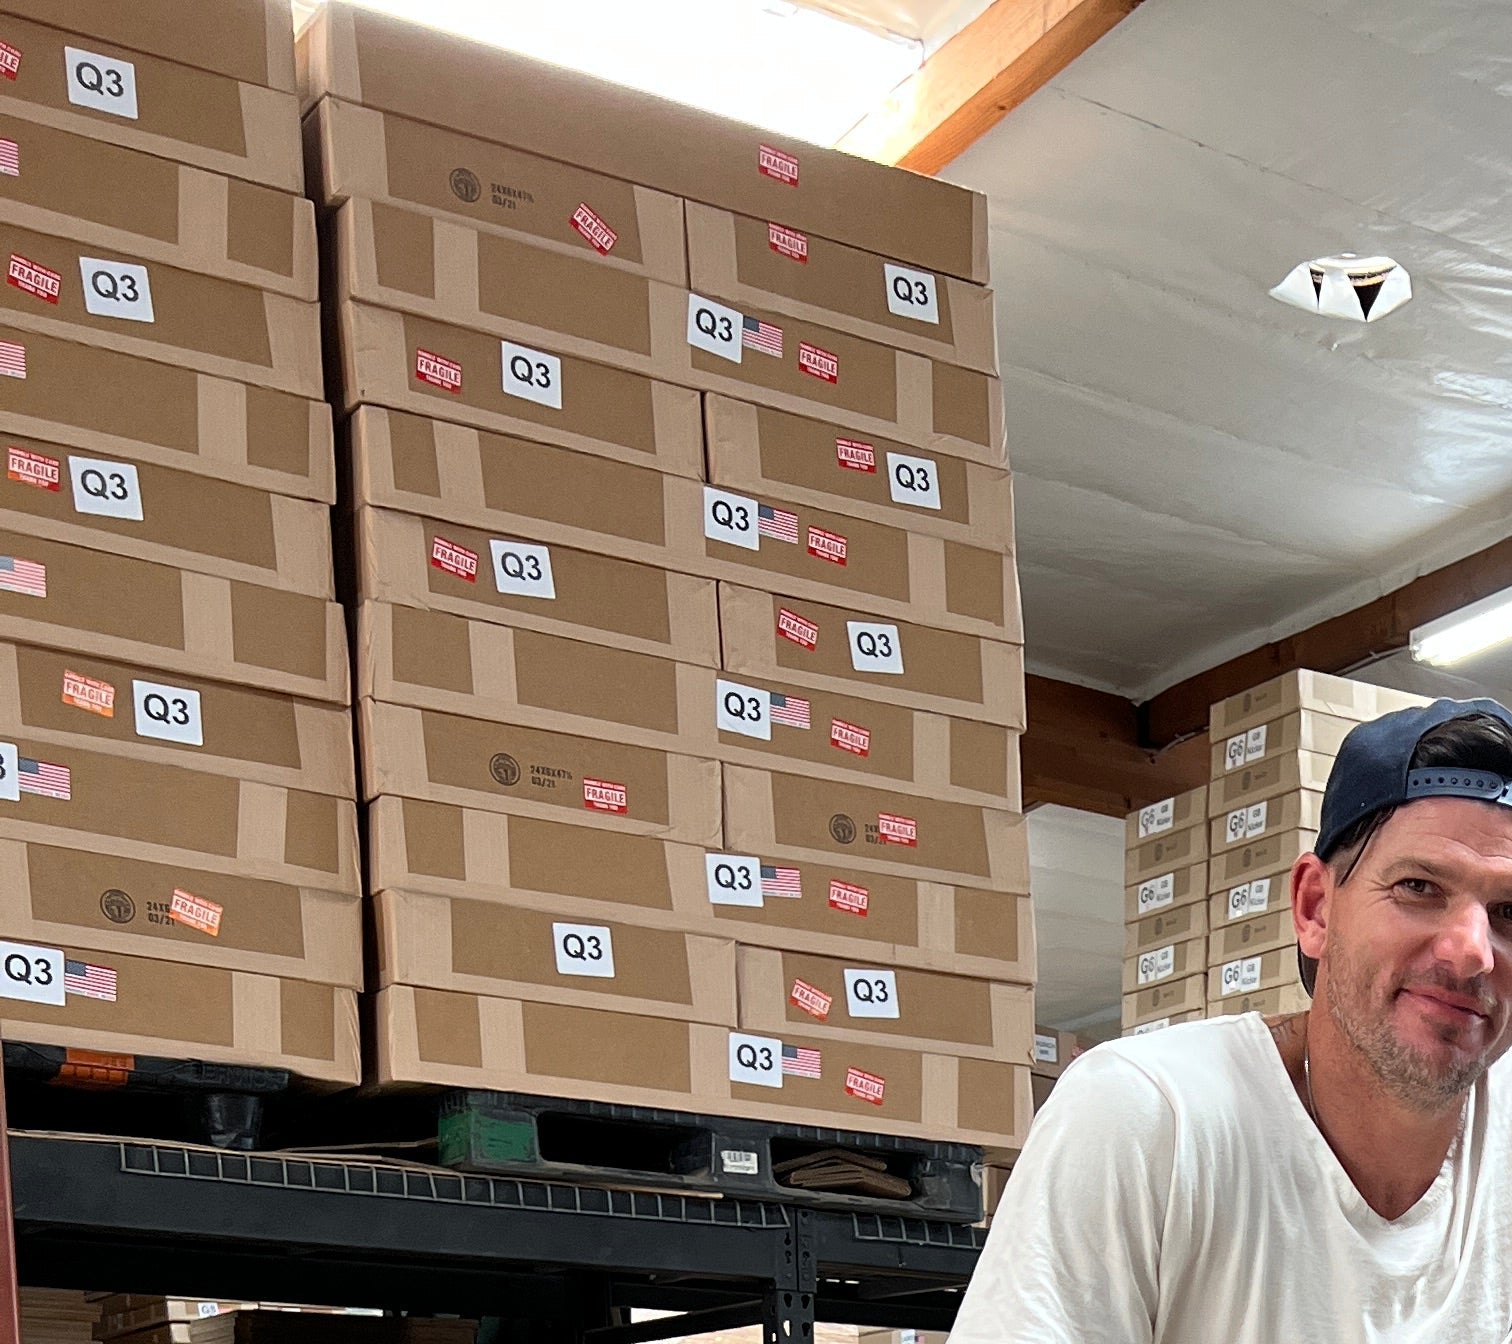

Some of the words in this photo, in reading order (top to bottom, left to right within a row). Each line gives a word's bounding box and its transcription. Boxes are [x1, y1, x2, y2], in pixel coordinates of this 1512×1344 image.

[76, 62, 124, 97] Q3
[760, 152, 798, 178] FRAGILE
[574, 209, 615, 251] FRAGILE
[770, 231, 808, 256] FRAGILE
[11, 264, 59, 294] FRAGILE
[92, 271, 139, 302] Q3
[893, 276, 929, 306] Q3
[696, 308, 733, 342] Q3
[418, 358, 462, 384] FRAGILE
[510, 356, 551, 389] Q3
[799, 350, 837, 377] FRAGILE
[837, 445, 874, 466] FRAGILE
[10, 457, 59, 482] FRAGILE
[896, 464, 930, 492] Q3
[81, 469, 128, 500] Q3
[712, 501, 749, 532] Q3
[434, 546, 476, 572] FRAGILE
[809, 535, 846, 559] FRAGILE
[501, 552, 542, 581] Q3
[779, 617, 816, 643] FRAGILE
[857, 632, 892, 658] Q3
[65, 681, 113, 705] FRAGILE
[144, 693, 189, 725] Q3
[724, 692, 761, 722] Q3
[831, 726, 869, 749] FRAGILE
[1228, 739, 1244, 759] G6
[586, 787, 626, 804] FRAGILE
[879, 821, 916, 840] FRAGILE
[1141, 808, 1155, 827] G6
[1229, 812, 1244, 832] G6
[715, 864, 752, 890] Q3
[830, 888, 867, 908] FRAGILE
[1140, 884, 1155, 904] G6
[1231, 888, 1247, 909] G6
[172, 898, 219, 926] FRAGILE
[563, 933, 603, 961] Q3
[5, 954, 53, 985] Q3
[1141, 956, 1155, 975] G6
[1224, 965, 1239, 985] G6
[791, 986, 829, 1013] FRAGILE
[853, 978, 889, 1004] Q3
[737, 1044, 773, 1071] Q3
[847, 1076, 884, 1097] FRAGILE
